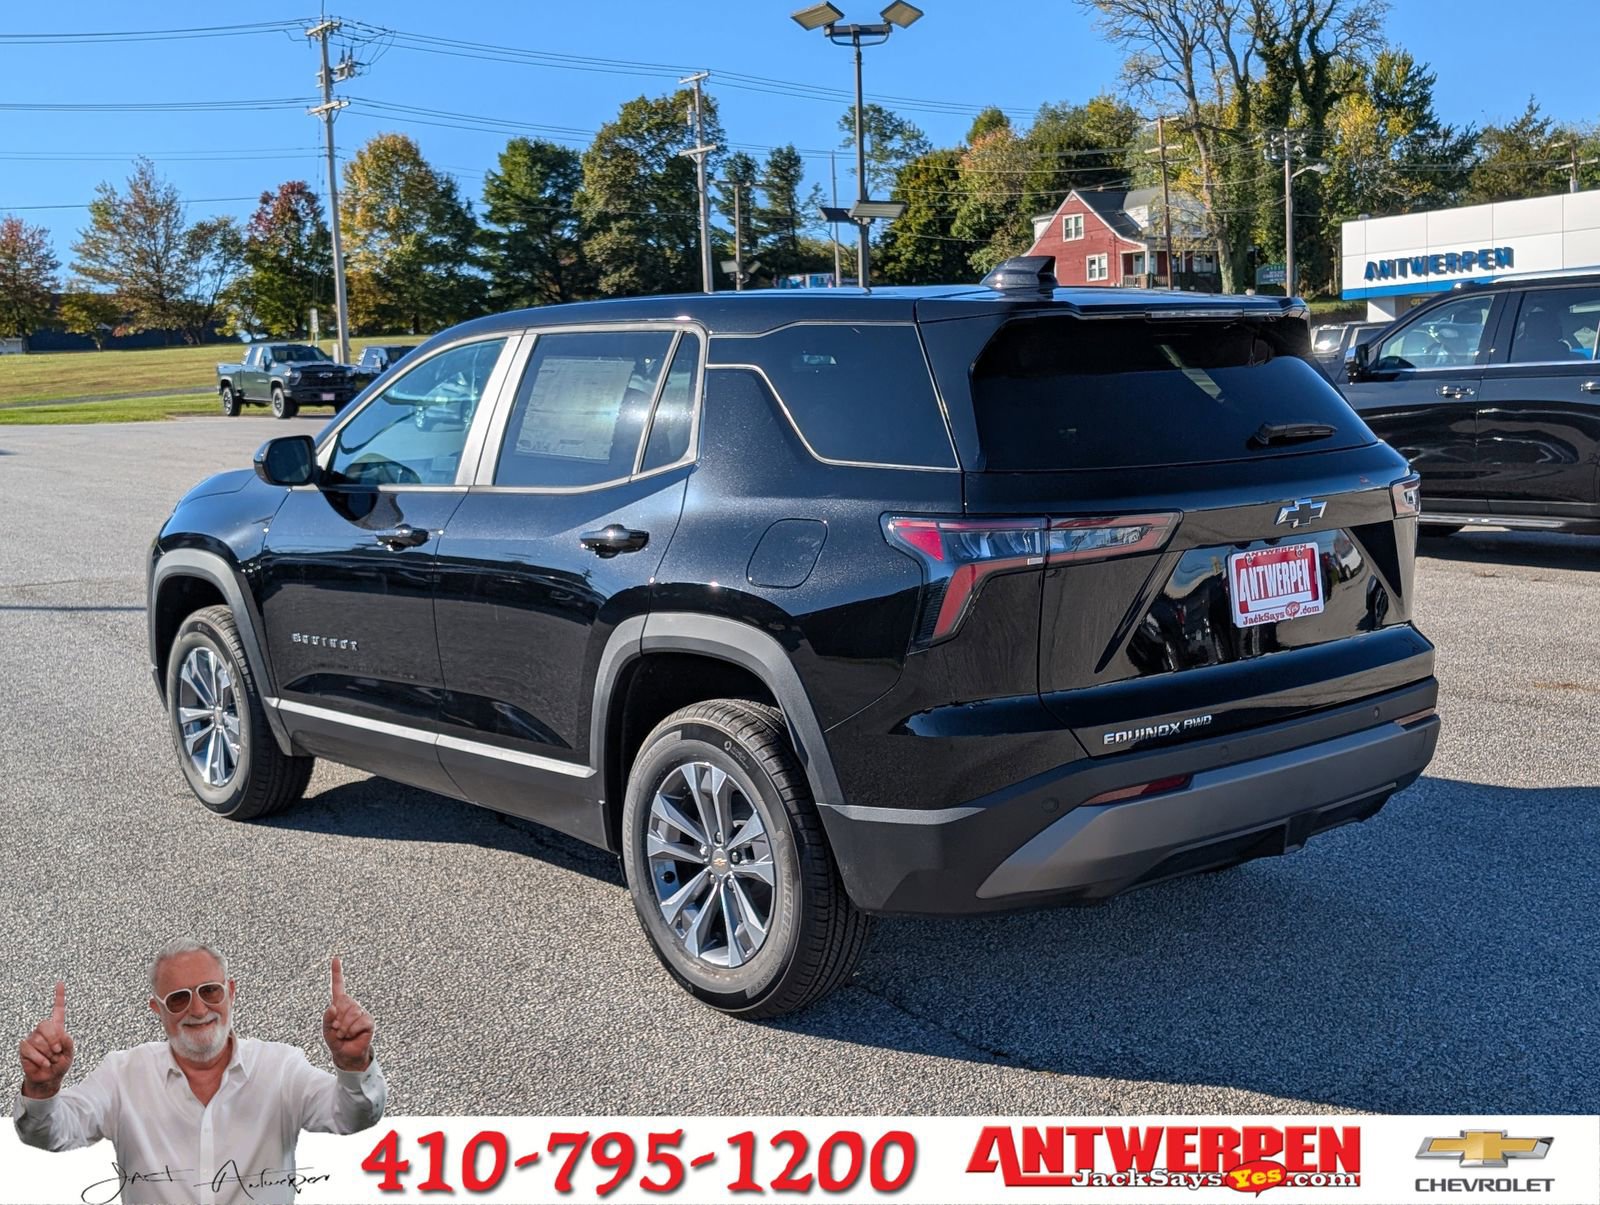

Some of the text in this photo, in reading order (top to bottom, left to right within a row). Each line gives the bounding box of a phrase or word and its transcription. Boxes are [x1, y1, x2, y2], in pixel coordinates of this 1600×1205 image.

[1364, 246, 1514, 282] ANTWERPEN
[1239, 558, 1311, 603] ANTWERPEN
[1103, 715, 1213, 745] EQUINOX AWD
